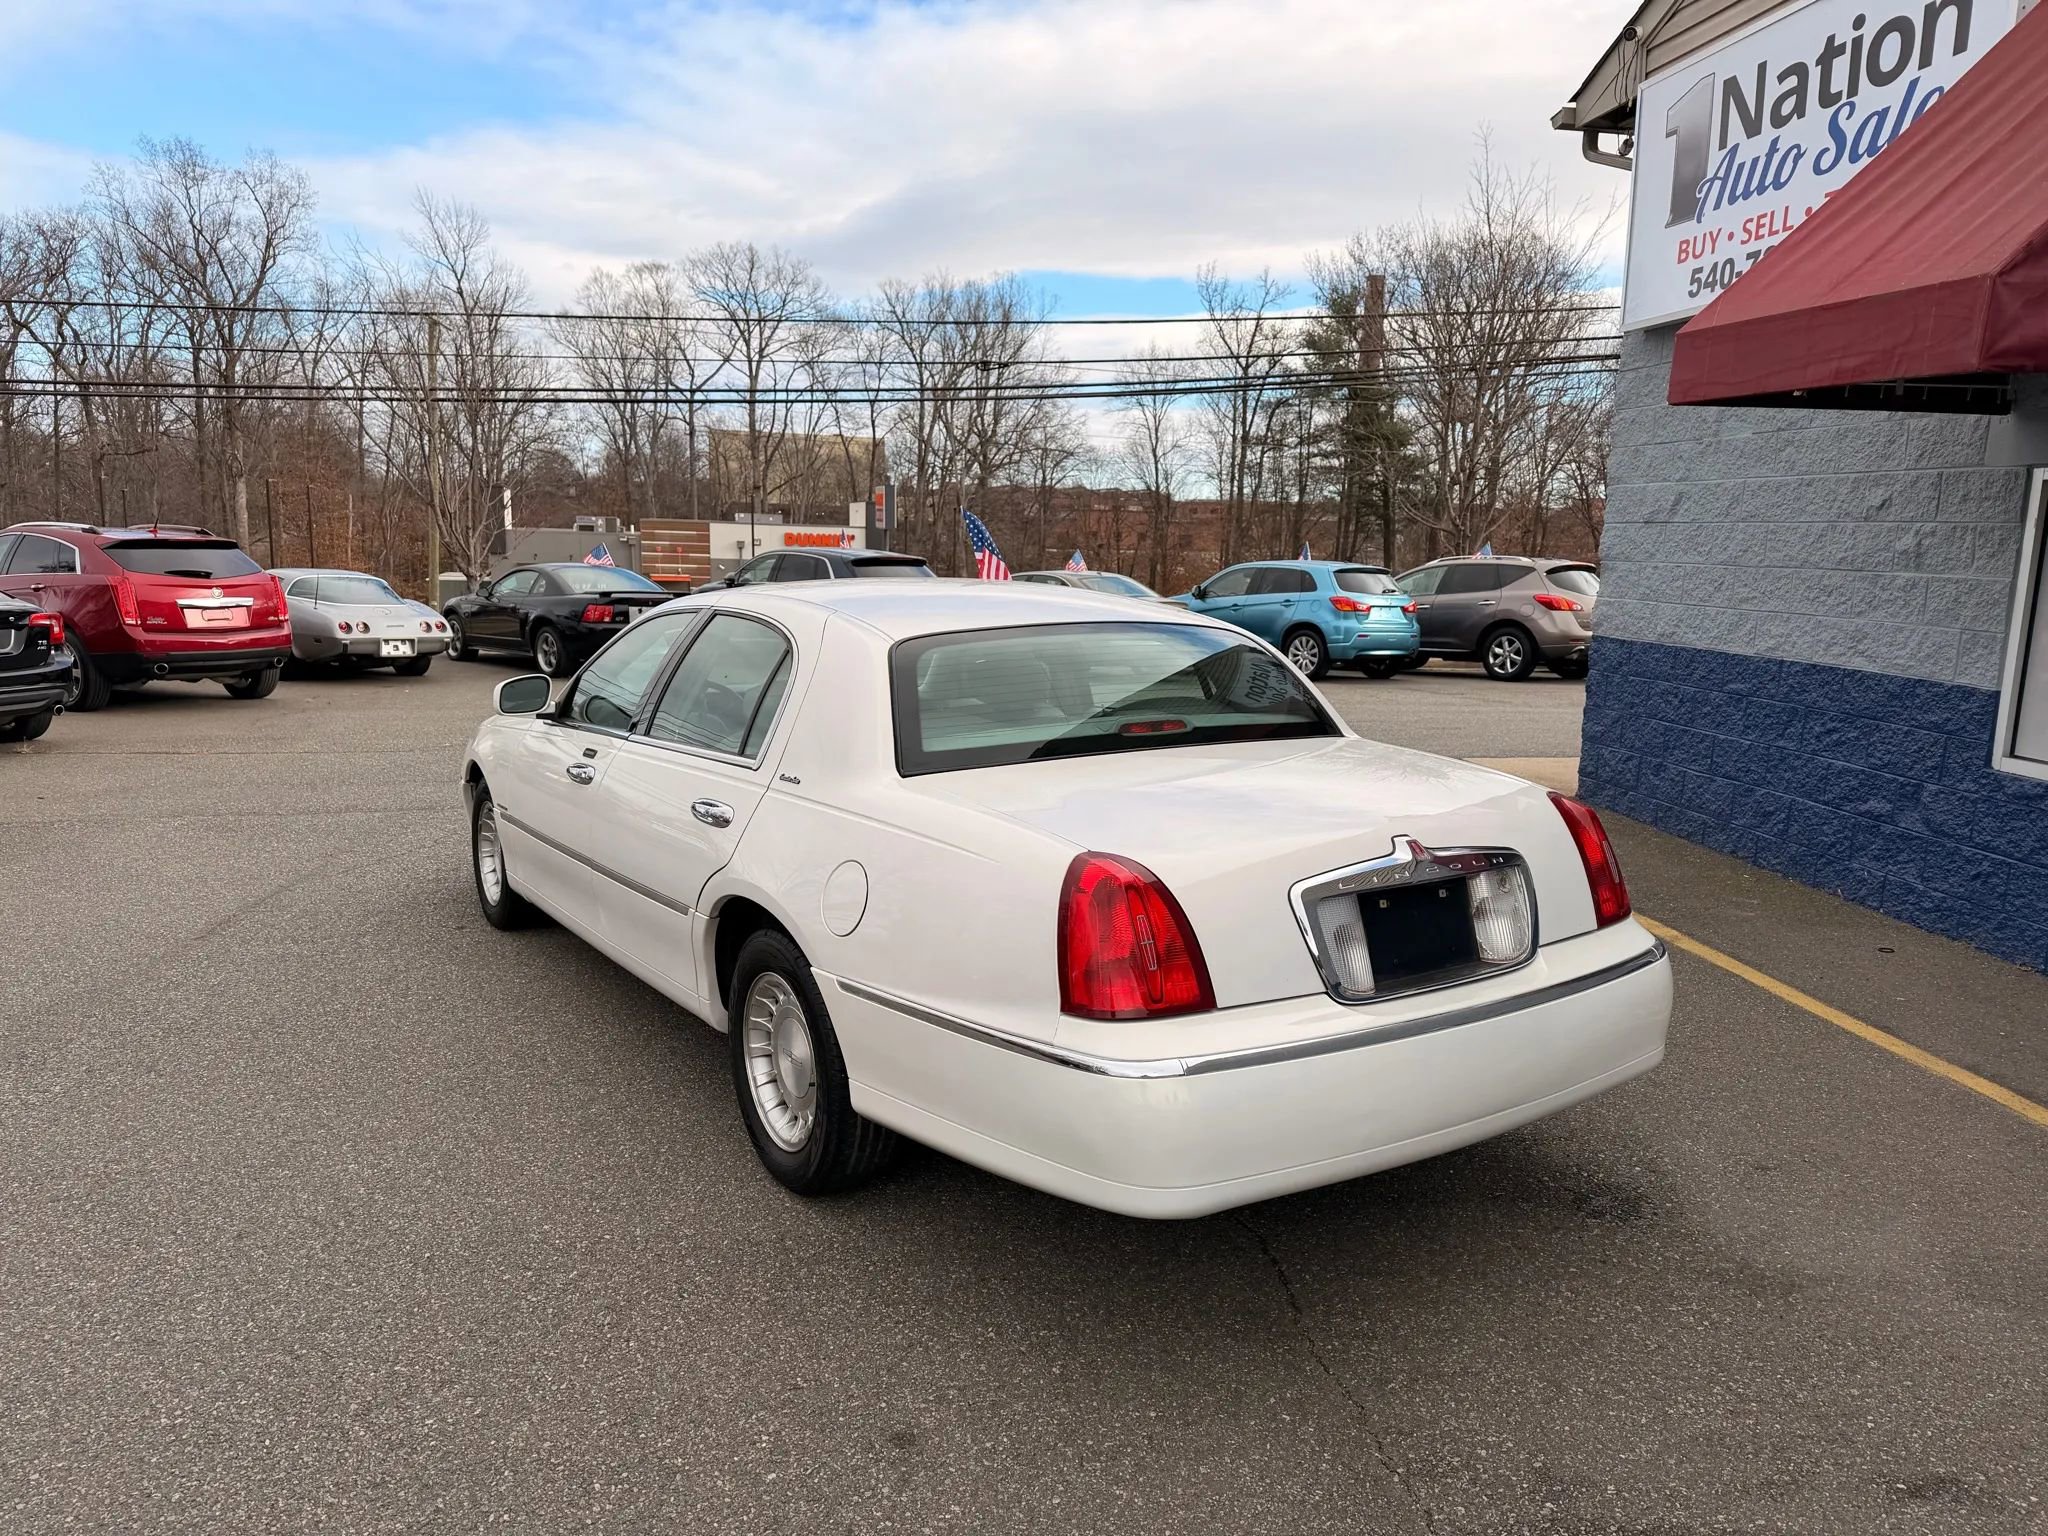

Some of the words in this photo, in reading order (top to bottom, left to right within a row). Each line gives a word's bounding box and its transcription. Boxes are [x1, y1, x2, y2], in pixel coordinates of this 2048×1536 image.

[1665, 72, 1715, 229] 1
[1718, 0, 1973, 151] Nation
[1695, 135, 1807, 224] Auto
[1677, 227, 1722, 265] BUY
[1740, 205, 1795, 245] SELL
[1688, 245, 1777, 299] 540-7
[1338, 856, 1504, 890] LINCOLN
